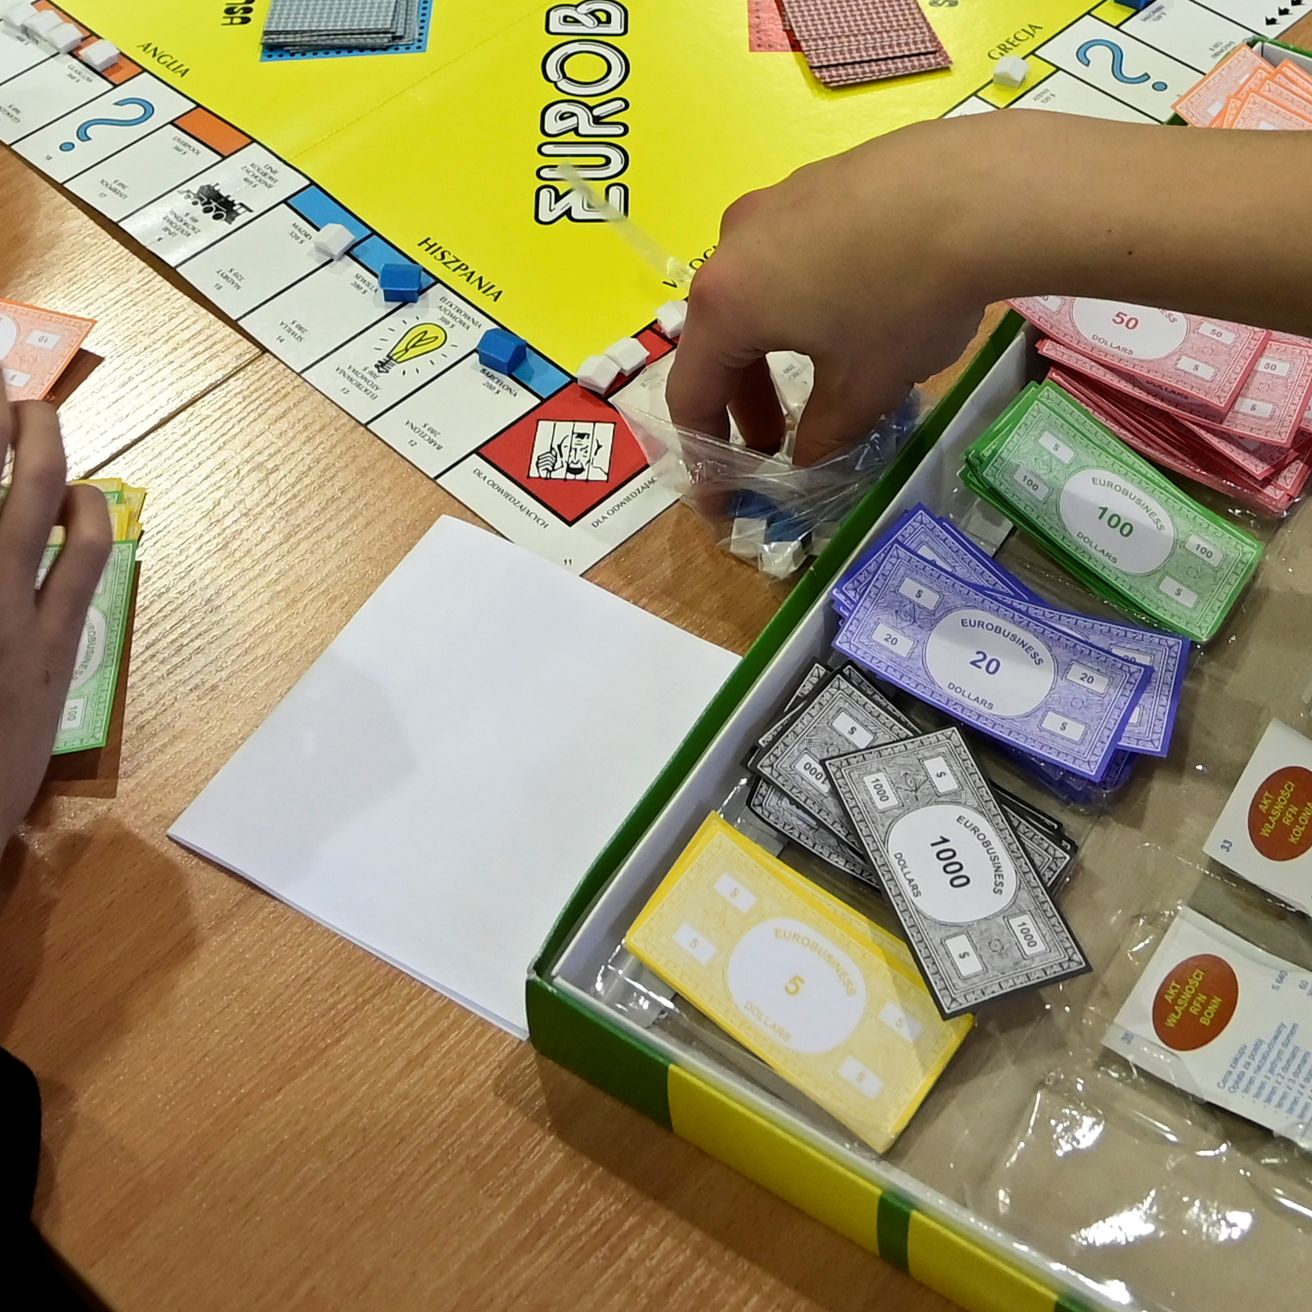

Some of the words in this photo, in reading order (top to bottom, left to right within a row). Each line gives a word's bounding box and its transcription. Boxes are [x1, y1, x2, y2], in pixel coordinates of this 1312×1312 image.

[987, 23, 1044, 61] GRECJA
[140, 42, 190, 78] ANGLIA
[216, 269, 241, 290] MADRYT
[417, 237, 503, 302] HISZPANIA
[438, 305, 470, 330] ATOMOWA
[439, 296, 482, 329] ELEKTROWNIA
[1111, 310, 1140, 331] 50
[36, 334, 51, 344] 10
[1090, 332, 1134, 356] DOLLARS
[1208, 328, 1224, 339] 50
[347, 364, 380, 391] ATOMOWA
[1262, 361, 1278, 372] 50
[336, 367, 378, 400] ELEKTROWNIA
[480, 368, 517, 397] BARCELONA
[405, 420, 443, 450] BARCELONA
[405, 437, 420, 448] 12
[1019, 474, 1041, 491] 100
[472, 468, 487, 481] DLA
[486, 480, 549, 529] ODWIEDZAJĄCYCH
[1089, 474, 1167, 534] EUROBUSINESS
[591, 513, 607, 529] DLA
[1094, 502, 1136, 540] 100
[1074, 530, 1120, 566] DOLLARS
[1193, 542, 1216, 560] 100
[563, 558, 573, 566] 11
[883, 632, 901, 646] 20
[959, 615, 1045, 668] EUROBUSINESS
[967, 648, 1002, 677] 20
[1078, 670, 1096, 686] 20
[946, 680, 996, 712] DOLLARS
[67, 705, 78, 722] 100
[869, 778, 892, 804] 1000
[1258, 790, 1274, 813] AKT
[1260, 781, 1295, 837] WŁASNOŚCI
[1282, 804, 1298, 826] RFN
[954, 813, 1007, 897] EUROBUSINESS
[1220, 839, 1233, 852] 33
[892, 850, 923, 900] DOLLARS
[928, 833, 973, 892] 1000
[689, 937, 701, 950] 5
[1019, 922, 1039, 950] 1000
[772, 926, 858, 998] EUROBUSINESS
[783, 974, 806, 998] 5
[1164, 980, 1181, 1004] AKT
[1165, 968, 1204, 1027] WŁASNOŚCI
[1189, 993, 1207, 1015] RFN
[1199, 996, 1222, 1026] BONN
[742, 1000, 794, 1044] DOLLARS
[894, 1016, 905, 1029] 5
